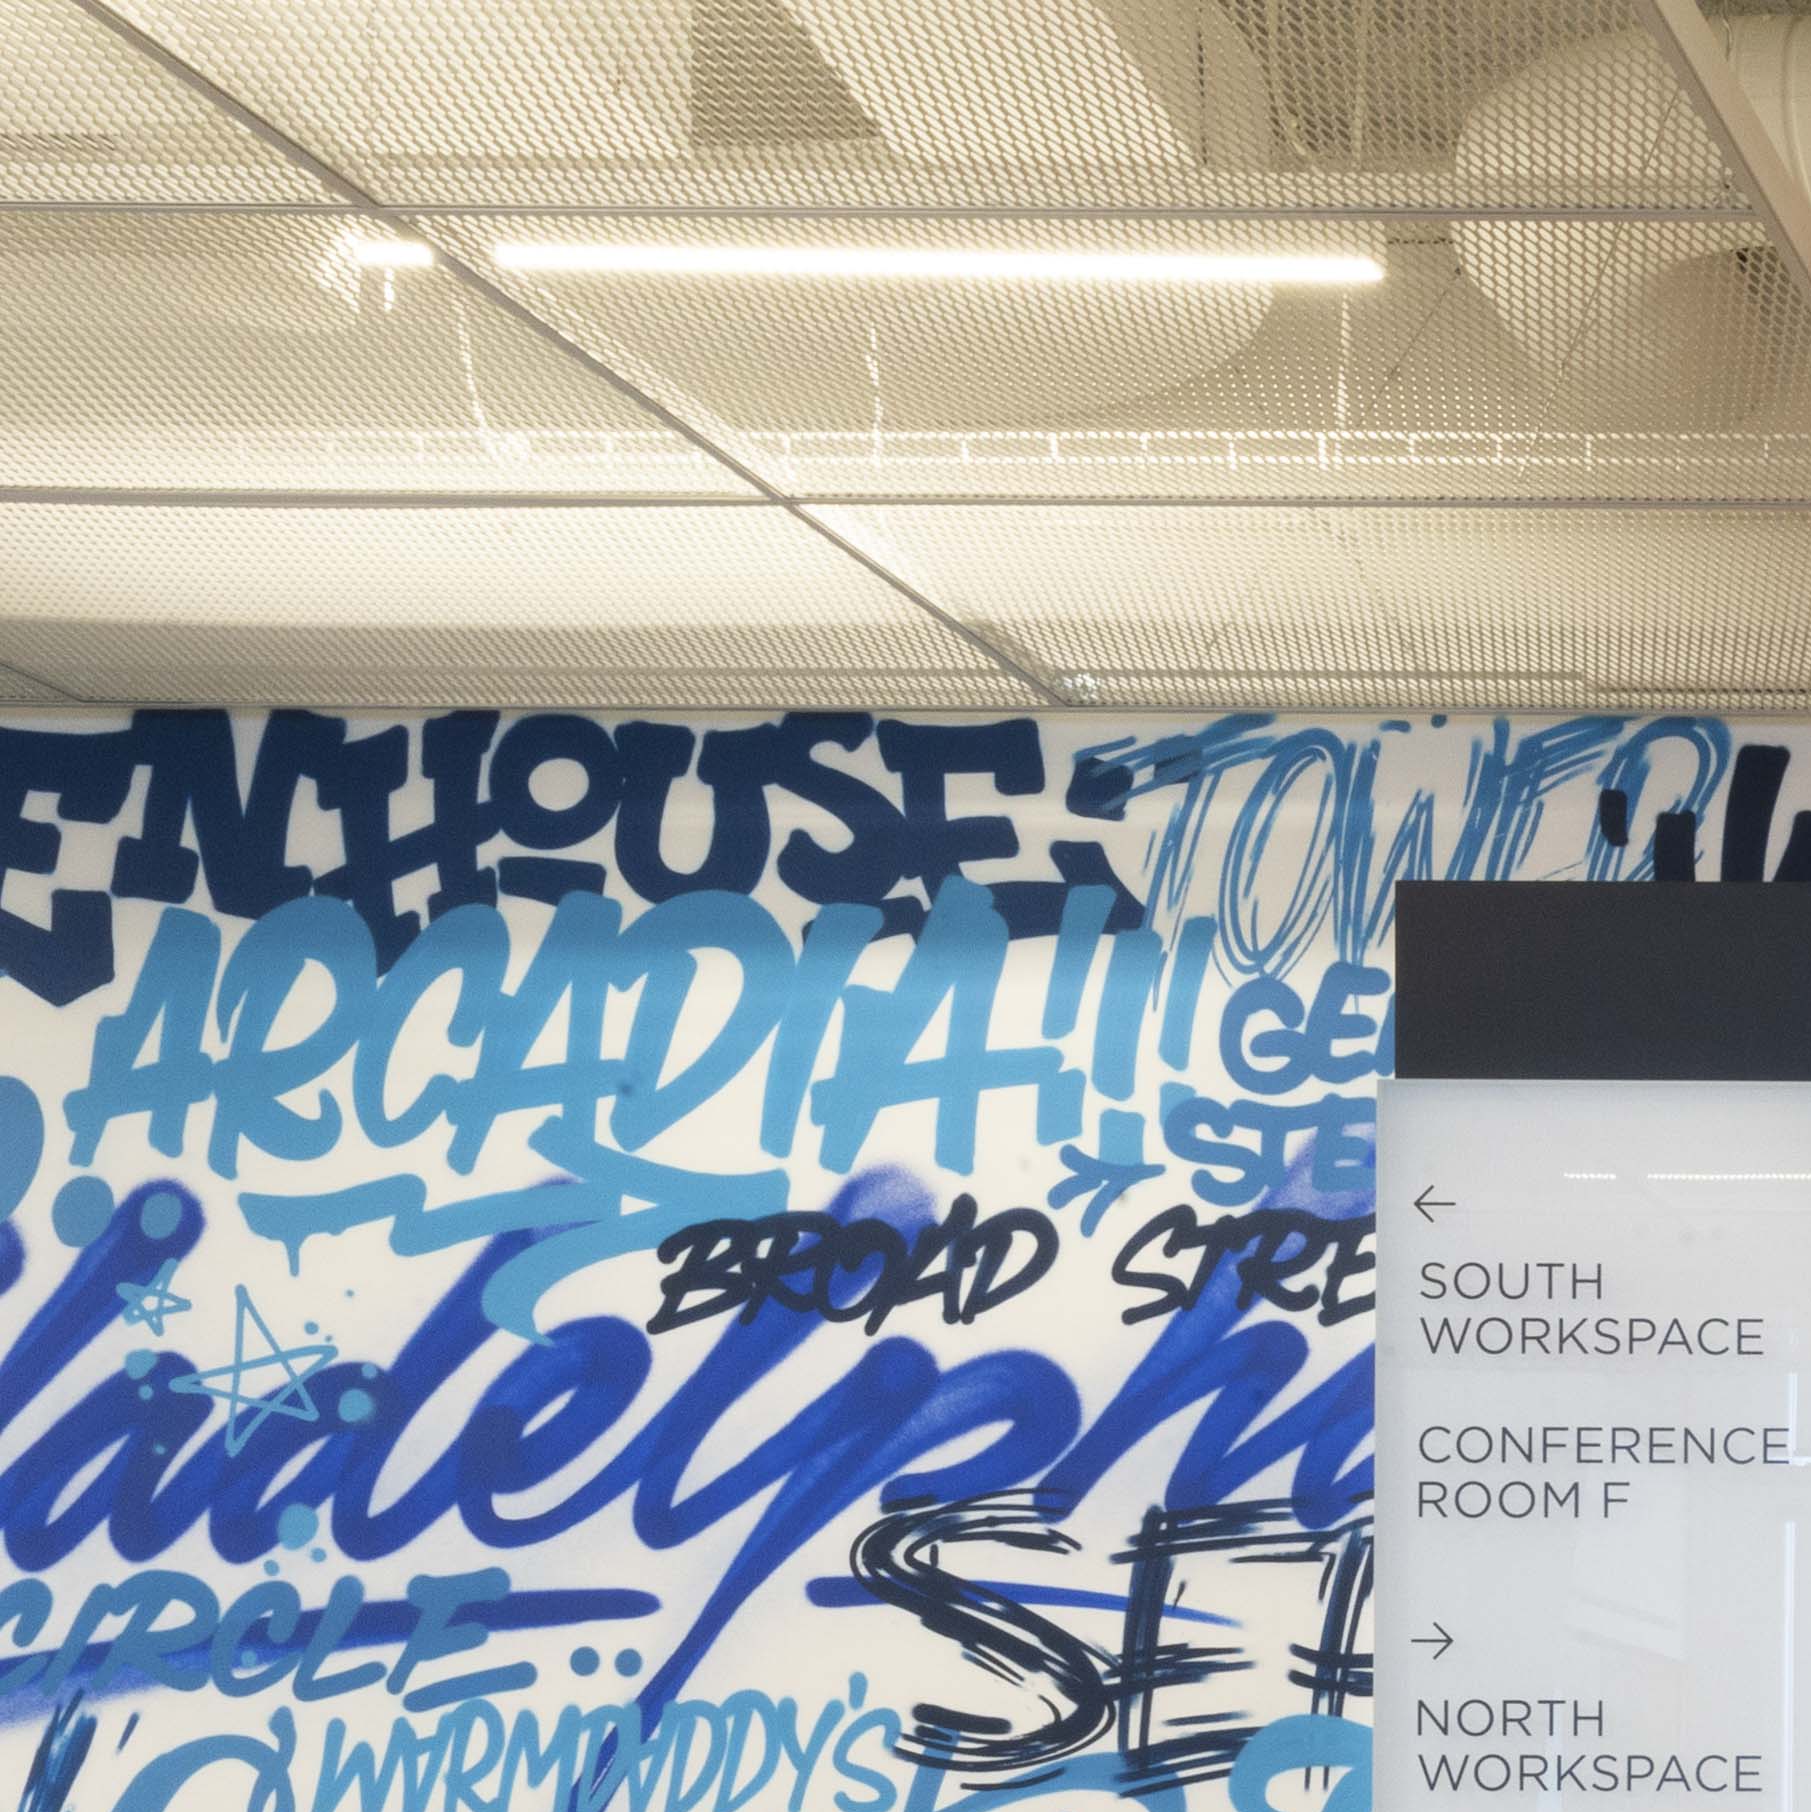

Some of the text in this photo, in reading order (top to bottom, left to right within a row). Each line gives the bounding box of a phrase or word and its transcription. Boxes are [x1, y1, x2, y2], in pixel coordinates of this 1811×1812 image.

[645, 1195, 1377, 1335] BROAD STRE
[1420, 1262, 1602, 1300] SOUTH
[1419, 1316, 1764, 1356] WORKSPACE
[1418, 1425, 1790, 1465] CONFERENCE
[1418, 1480, 1630, 1519] ROOM F
[1417, 1699, 1603, 1737] NORTH
[1418, 1753, 1762, 1793] WORKSPACE
